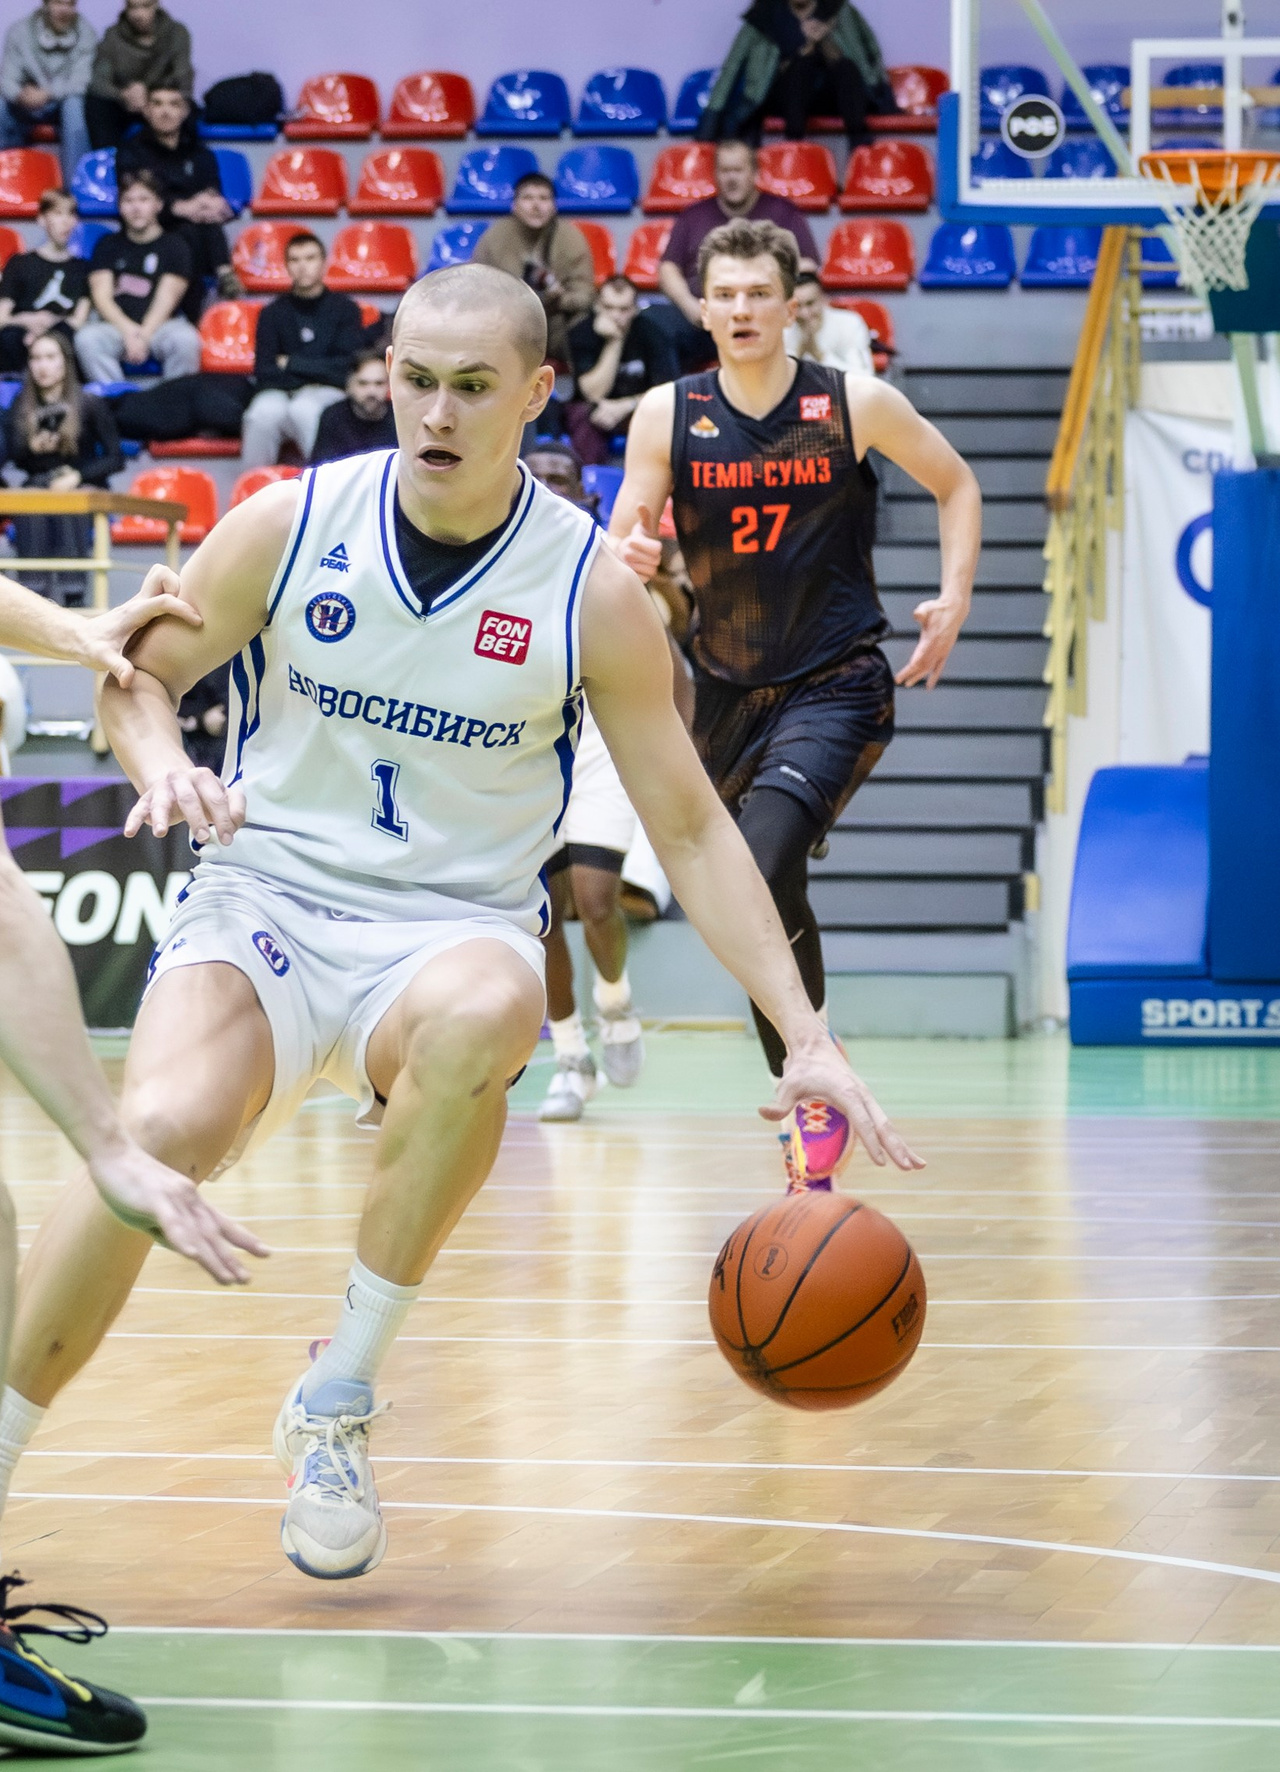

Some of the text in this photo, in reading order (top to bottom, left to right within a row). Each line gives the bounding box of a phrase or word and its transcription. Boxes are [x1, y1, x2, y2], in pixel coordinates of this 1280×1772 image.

[690, 457, 832, 489] ТЕМП-СУМЗ
[731, 504, 791, 554] 27
[320, 557, 352, 573] PEAK
[481, 615, 530, 640] FON
[477, 637, 526, 658] BET
[288, 663, 527, 748] НОВОСИБИРСК
[371, 758, 408, 842] 1
